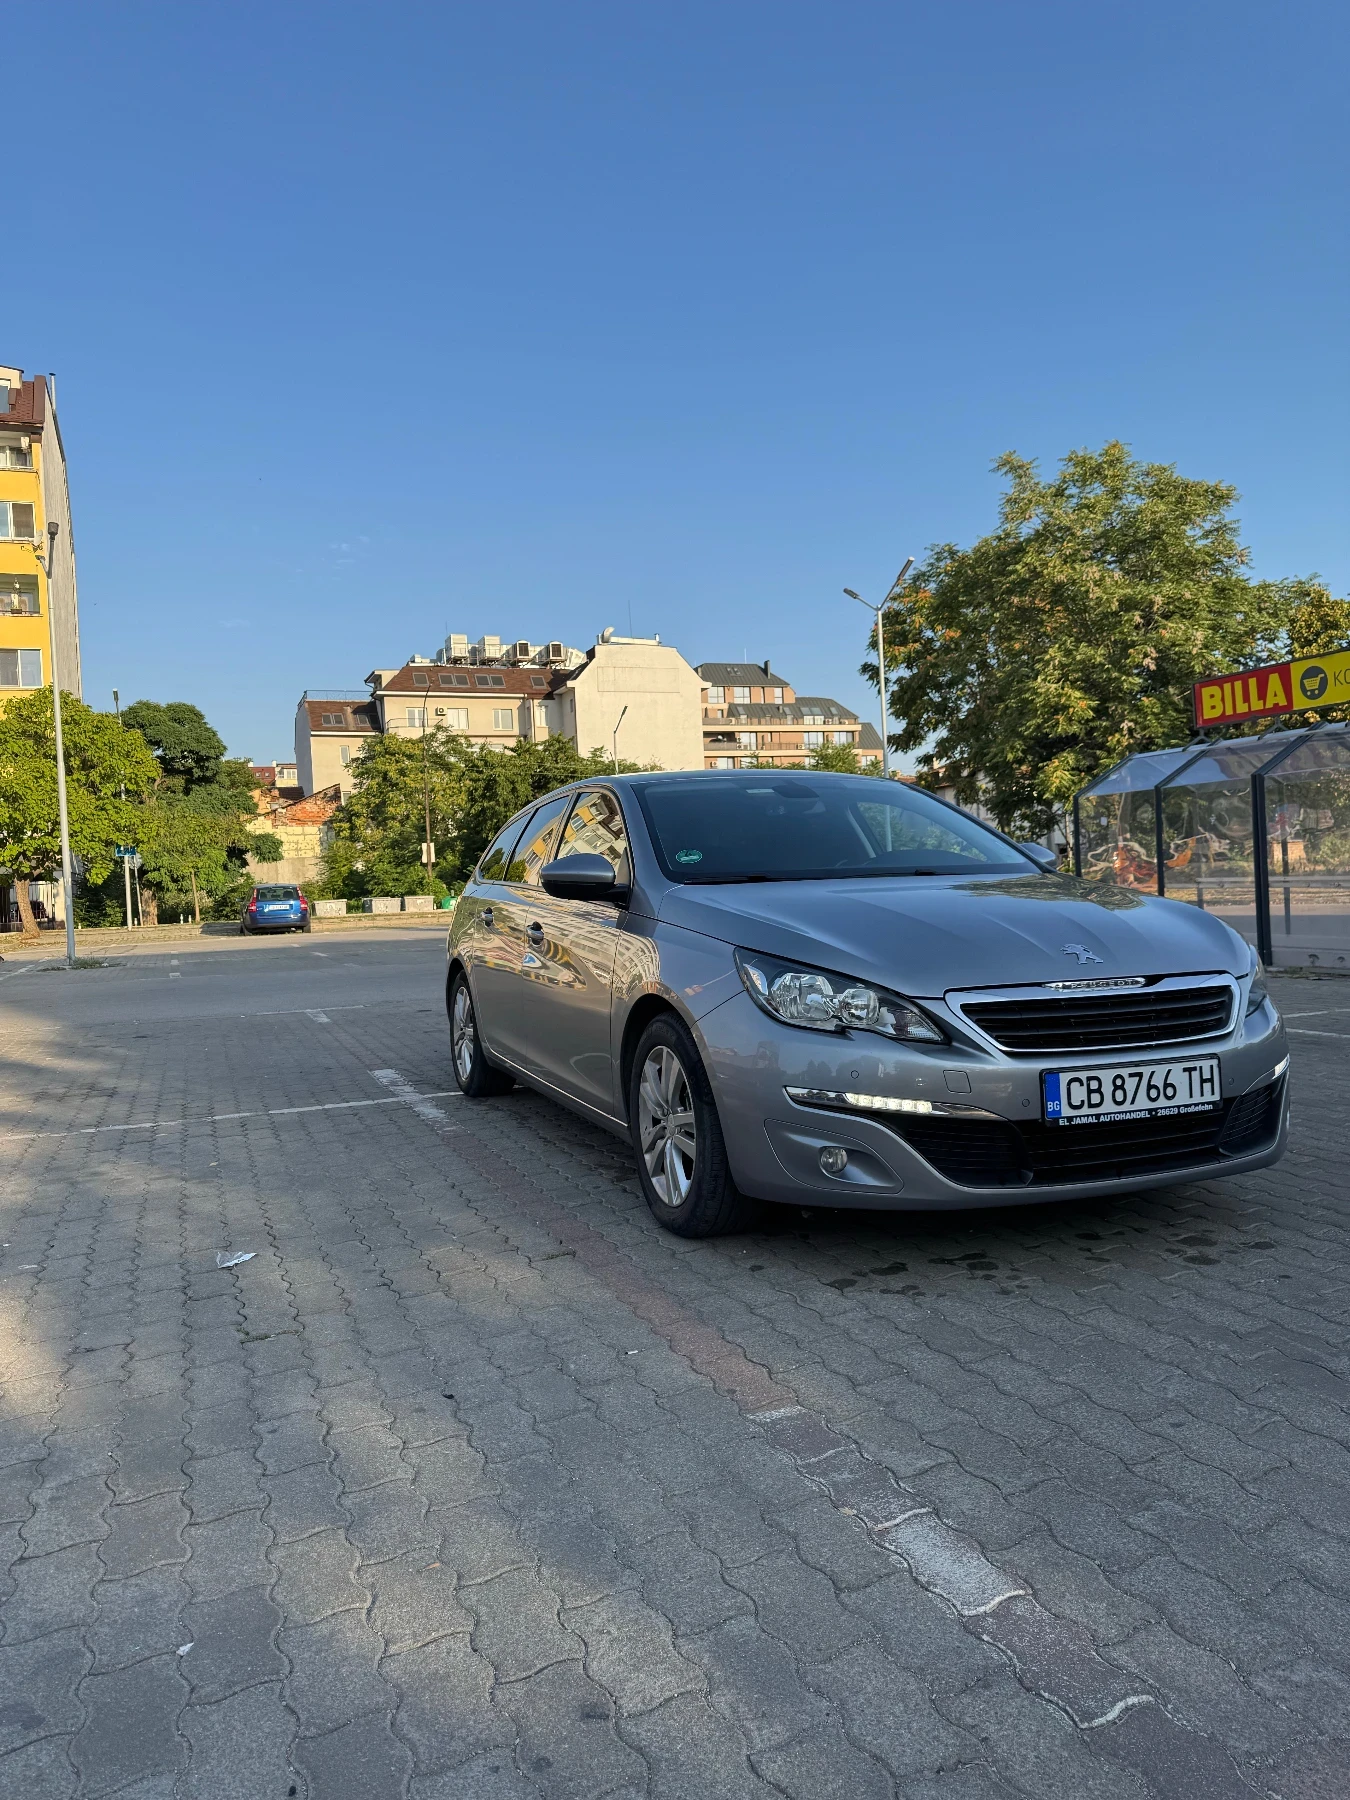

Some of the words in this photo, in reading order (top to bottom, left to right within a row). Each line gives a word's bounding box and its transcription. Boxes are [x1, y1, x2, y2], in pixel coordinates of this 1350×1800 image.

[1201, 672, 1288, 720] BILLA
[1066, 1075, 1104, 1110] CB
[1111, 1069, 1177, 1106] 8766
[1182, 1064, 1215, 1099] TH
[1047, 1101, 1060, 1111] BG
[1059, 1118, 1069, 1126] EL
[1071, 1116, 1098, 1125] JAMAL
[1099, 1111, 1151, 1122] AUTOHANDEL
[1157, 1107, 1178, 1117] 26629
